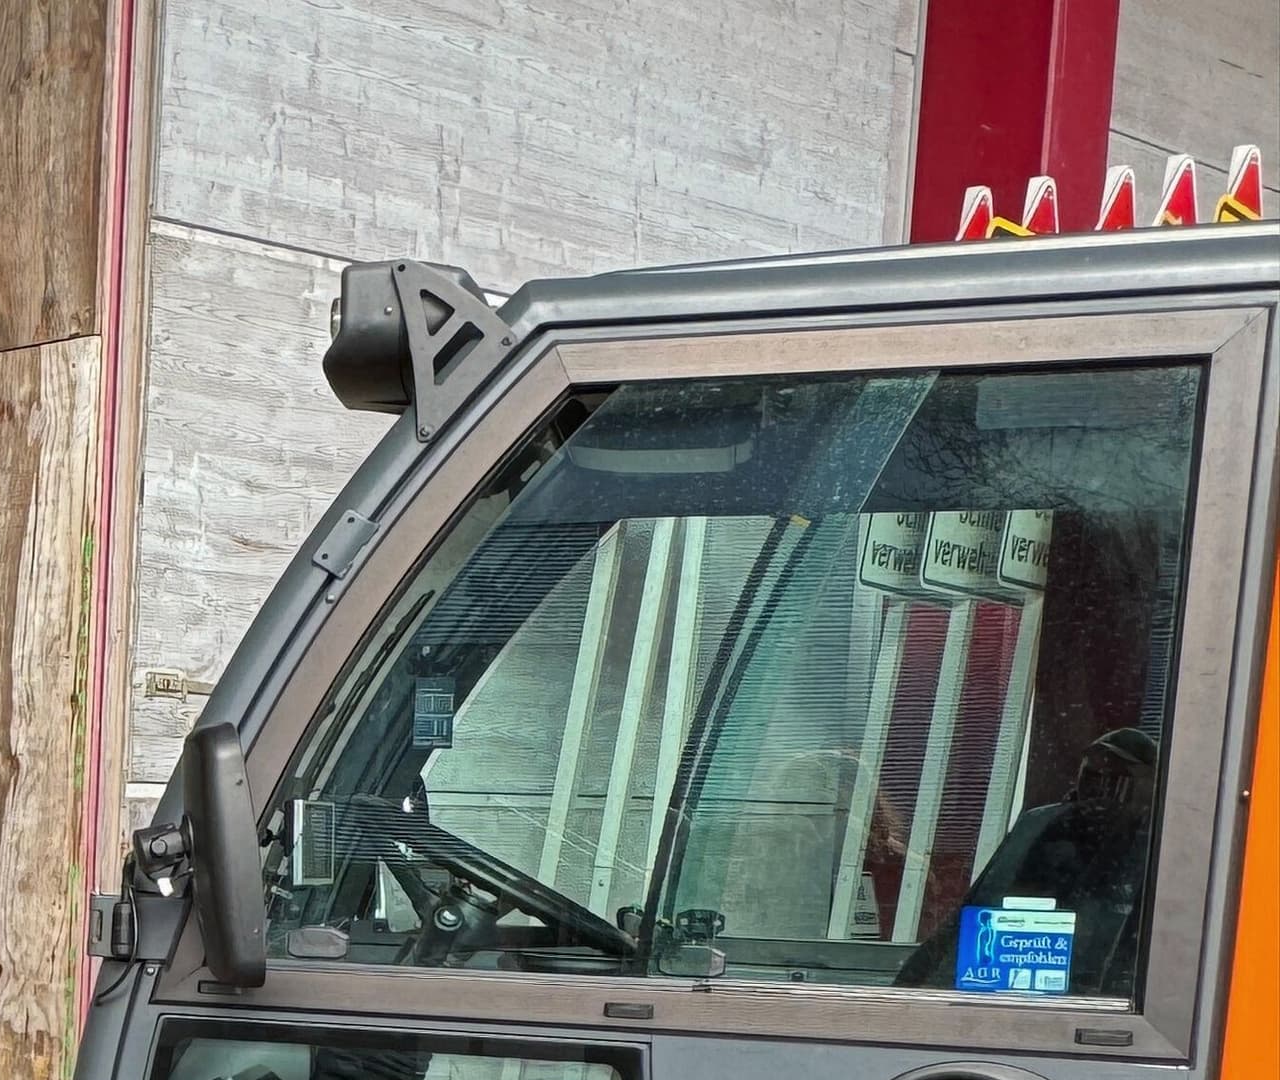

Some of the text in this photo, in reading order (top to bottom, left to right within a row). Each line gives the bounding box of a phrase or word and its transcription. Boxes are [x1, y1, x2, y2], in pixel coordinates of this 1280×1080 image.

[1000, 935, 1069, 952] Geprüft &
[999, 951, 1068, 968] empfohlen
